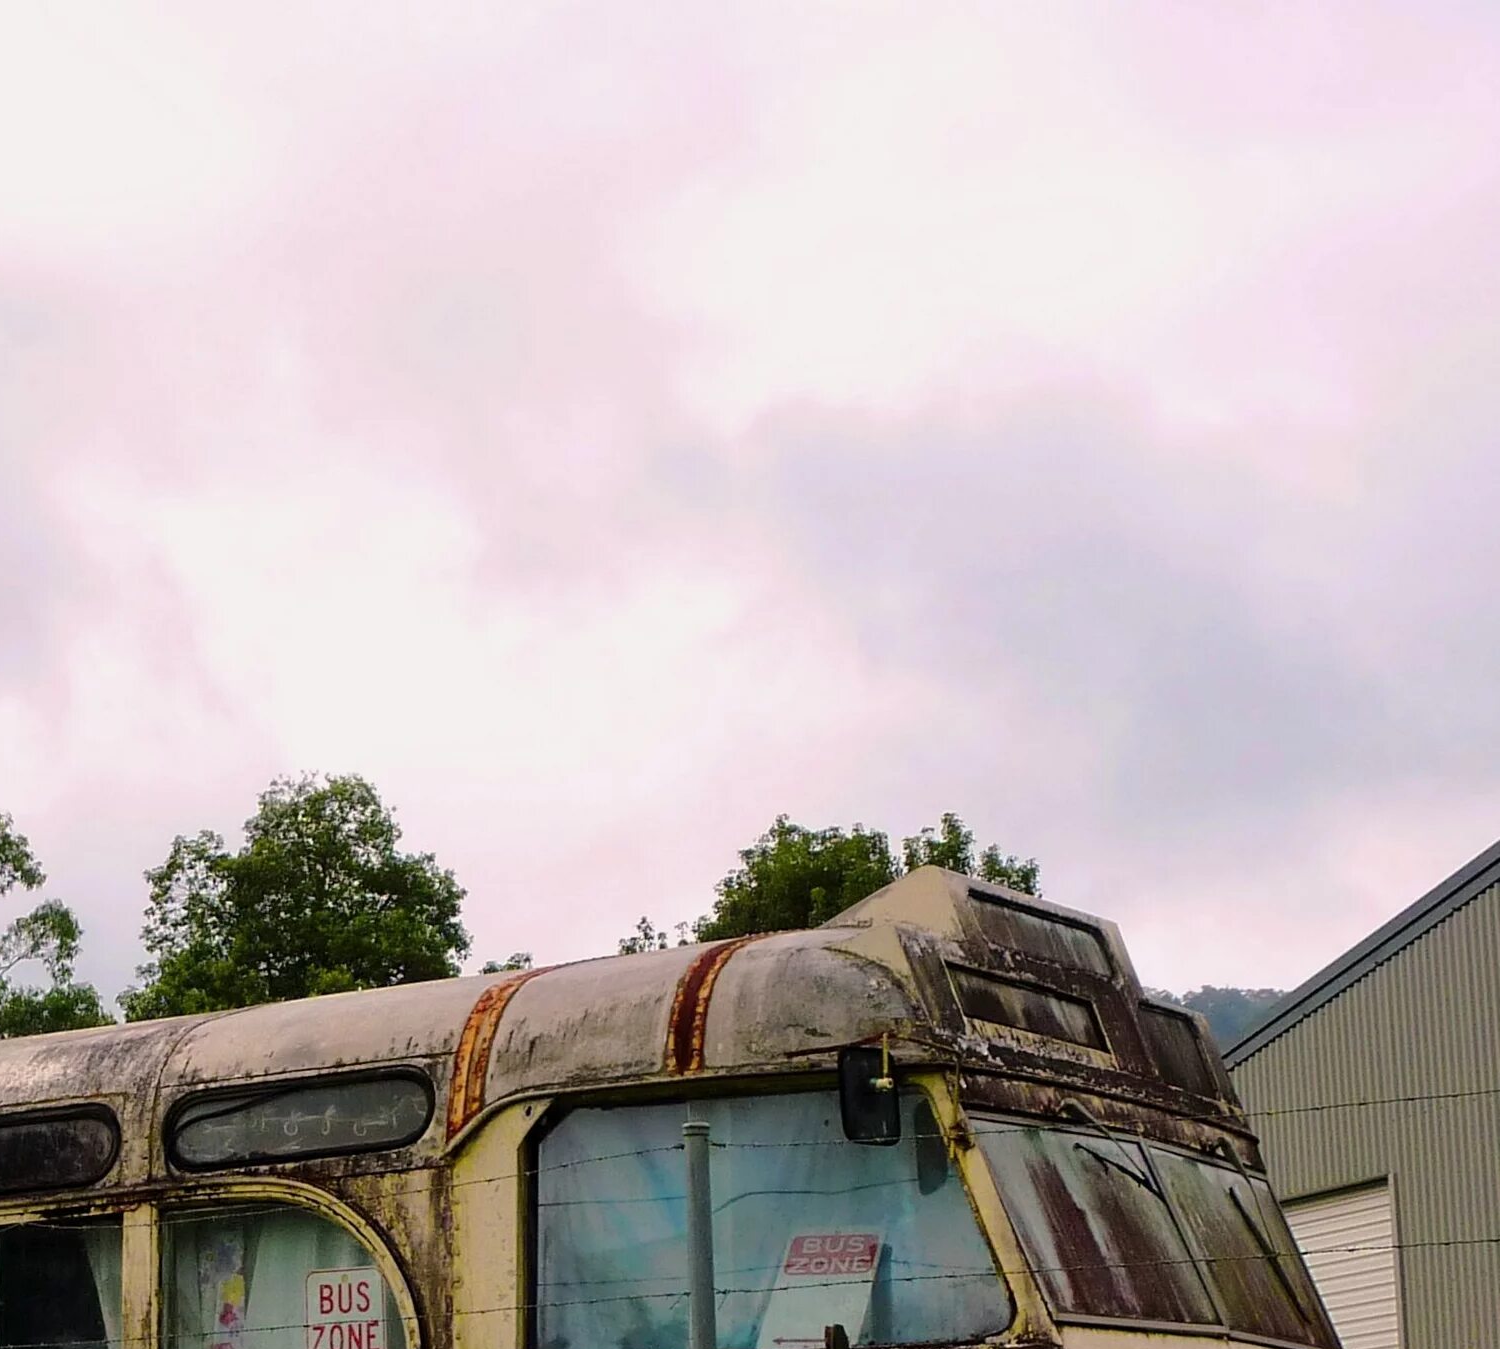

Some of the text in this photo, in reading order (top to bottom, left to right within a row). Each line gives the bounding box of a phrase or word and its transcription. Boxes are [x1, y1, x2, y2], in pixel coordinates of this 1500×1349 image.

[802, 1236, 865, 1254] BUS
[786, 1255, 872, 1274] ZONE
[319, 1281, 370, 1315] BUS
